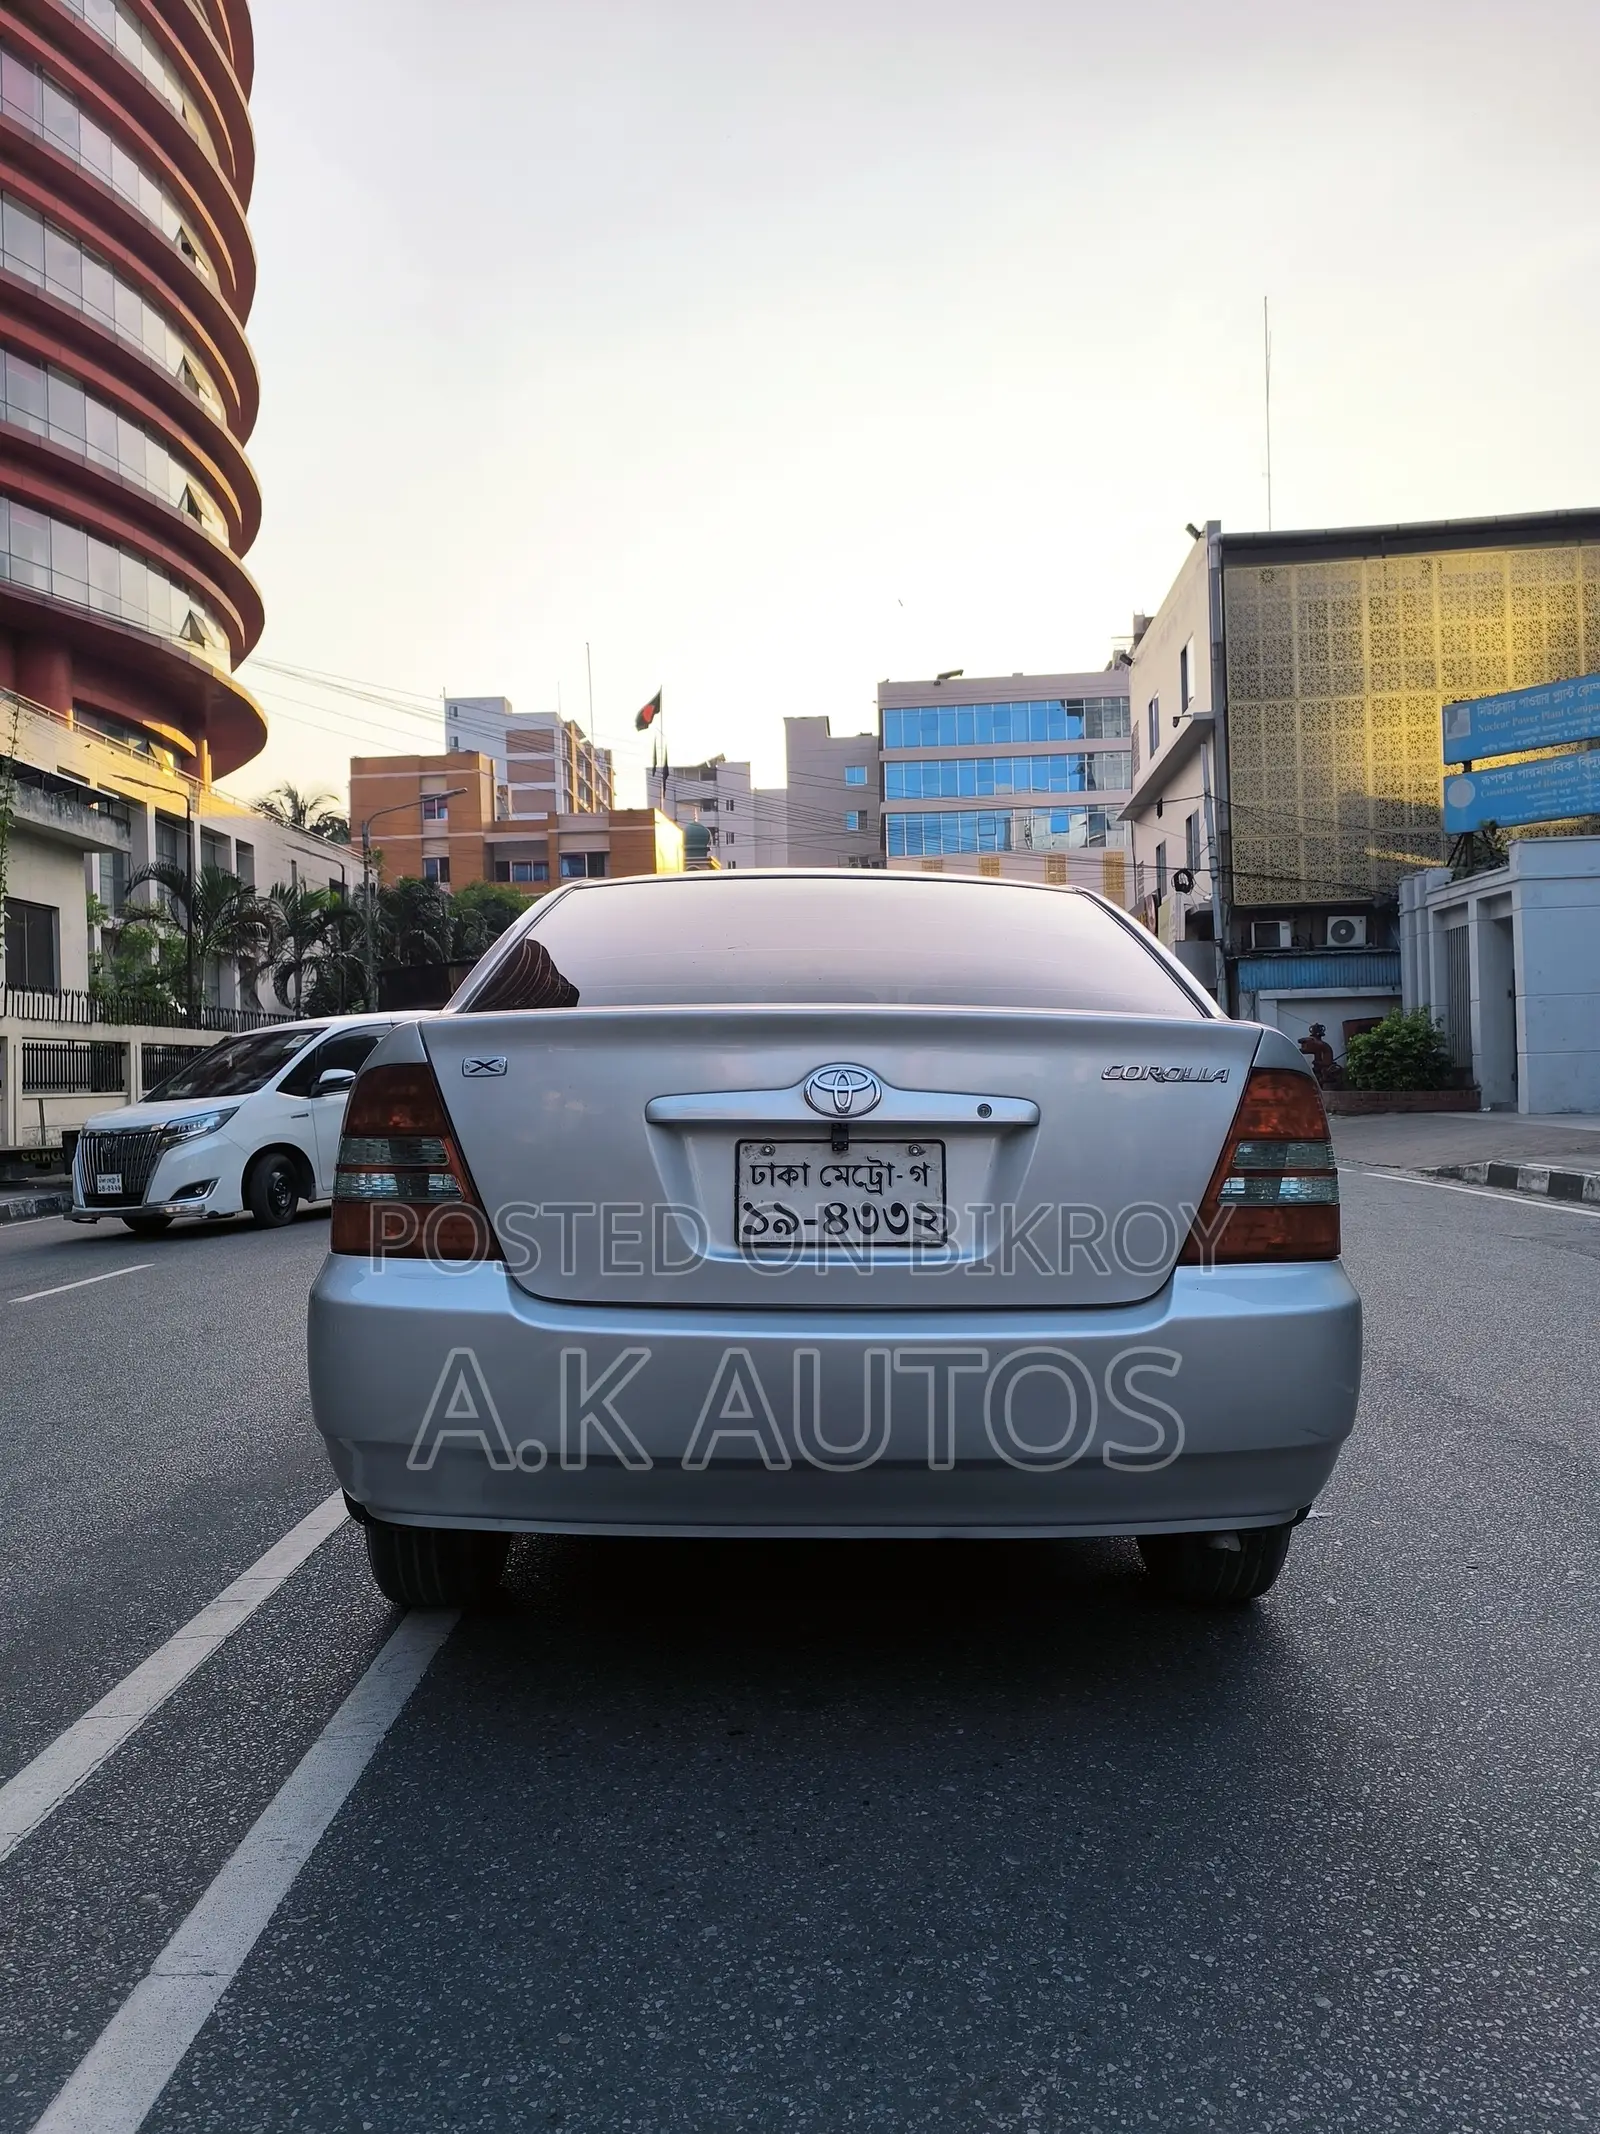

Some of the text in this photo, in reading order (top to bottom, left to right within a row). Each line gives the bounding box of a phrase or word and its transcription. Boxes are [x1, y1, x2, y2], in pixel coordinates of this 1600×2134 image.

[1478, 720, 1511, 733] Nuclear
[1512, 714, 1539, 727] Power
[1542, 708, 1564, 722] Plant
[1567, 702, 1600, 717] Compa
[1481, 784, 1531, 799] Construction
[1533, 781, 1542, 791] of
[1582, 769, 1600, 781] Nuc
[469, 1059, 500, 1074] X
[1101, 1064, 1230, 1083] COROLLA
[749, 1162, 811, 1187] ঢাকা
[742, 1201, 941, 1236] ১৯-৪৩৩২
